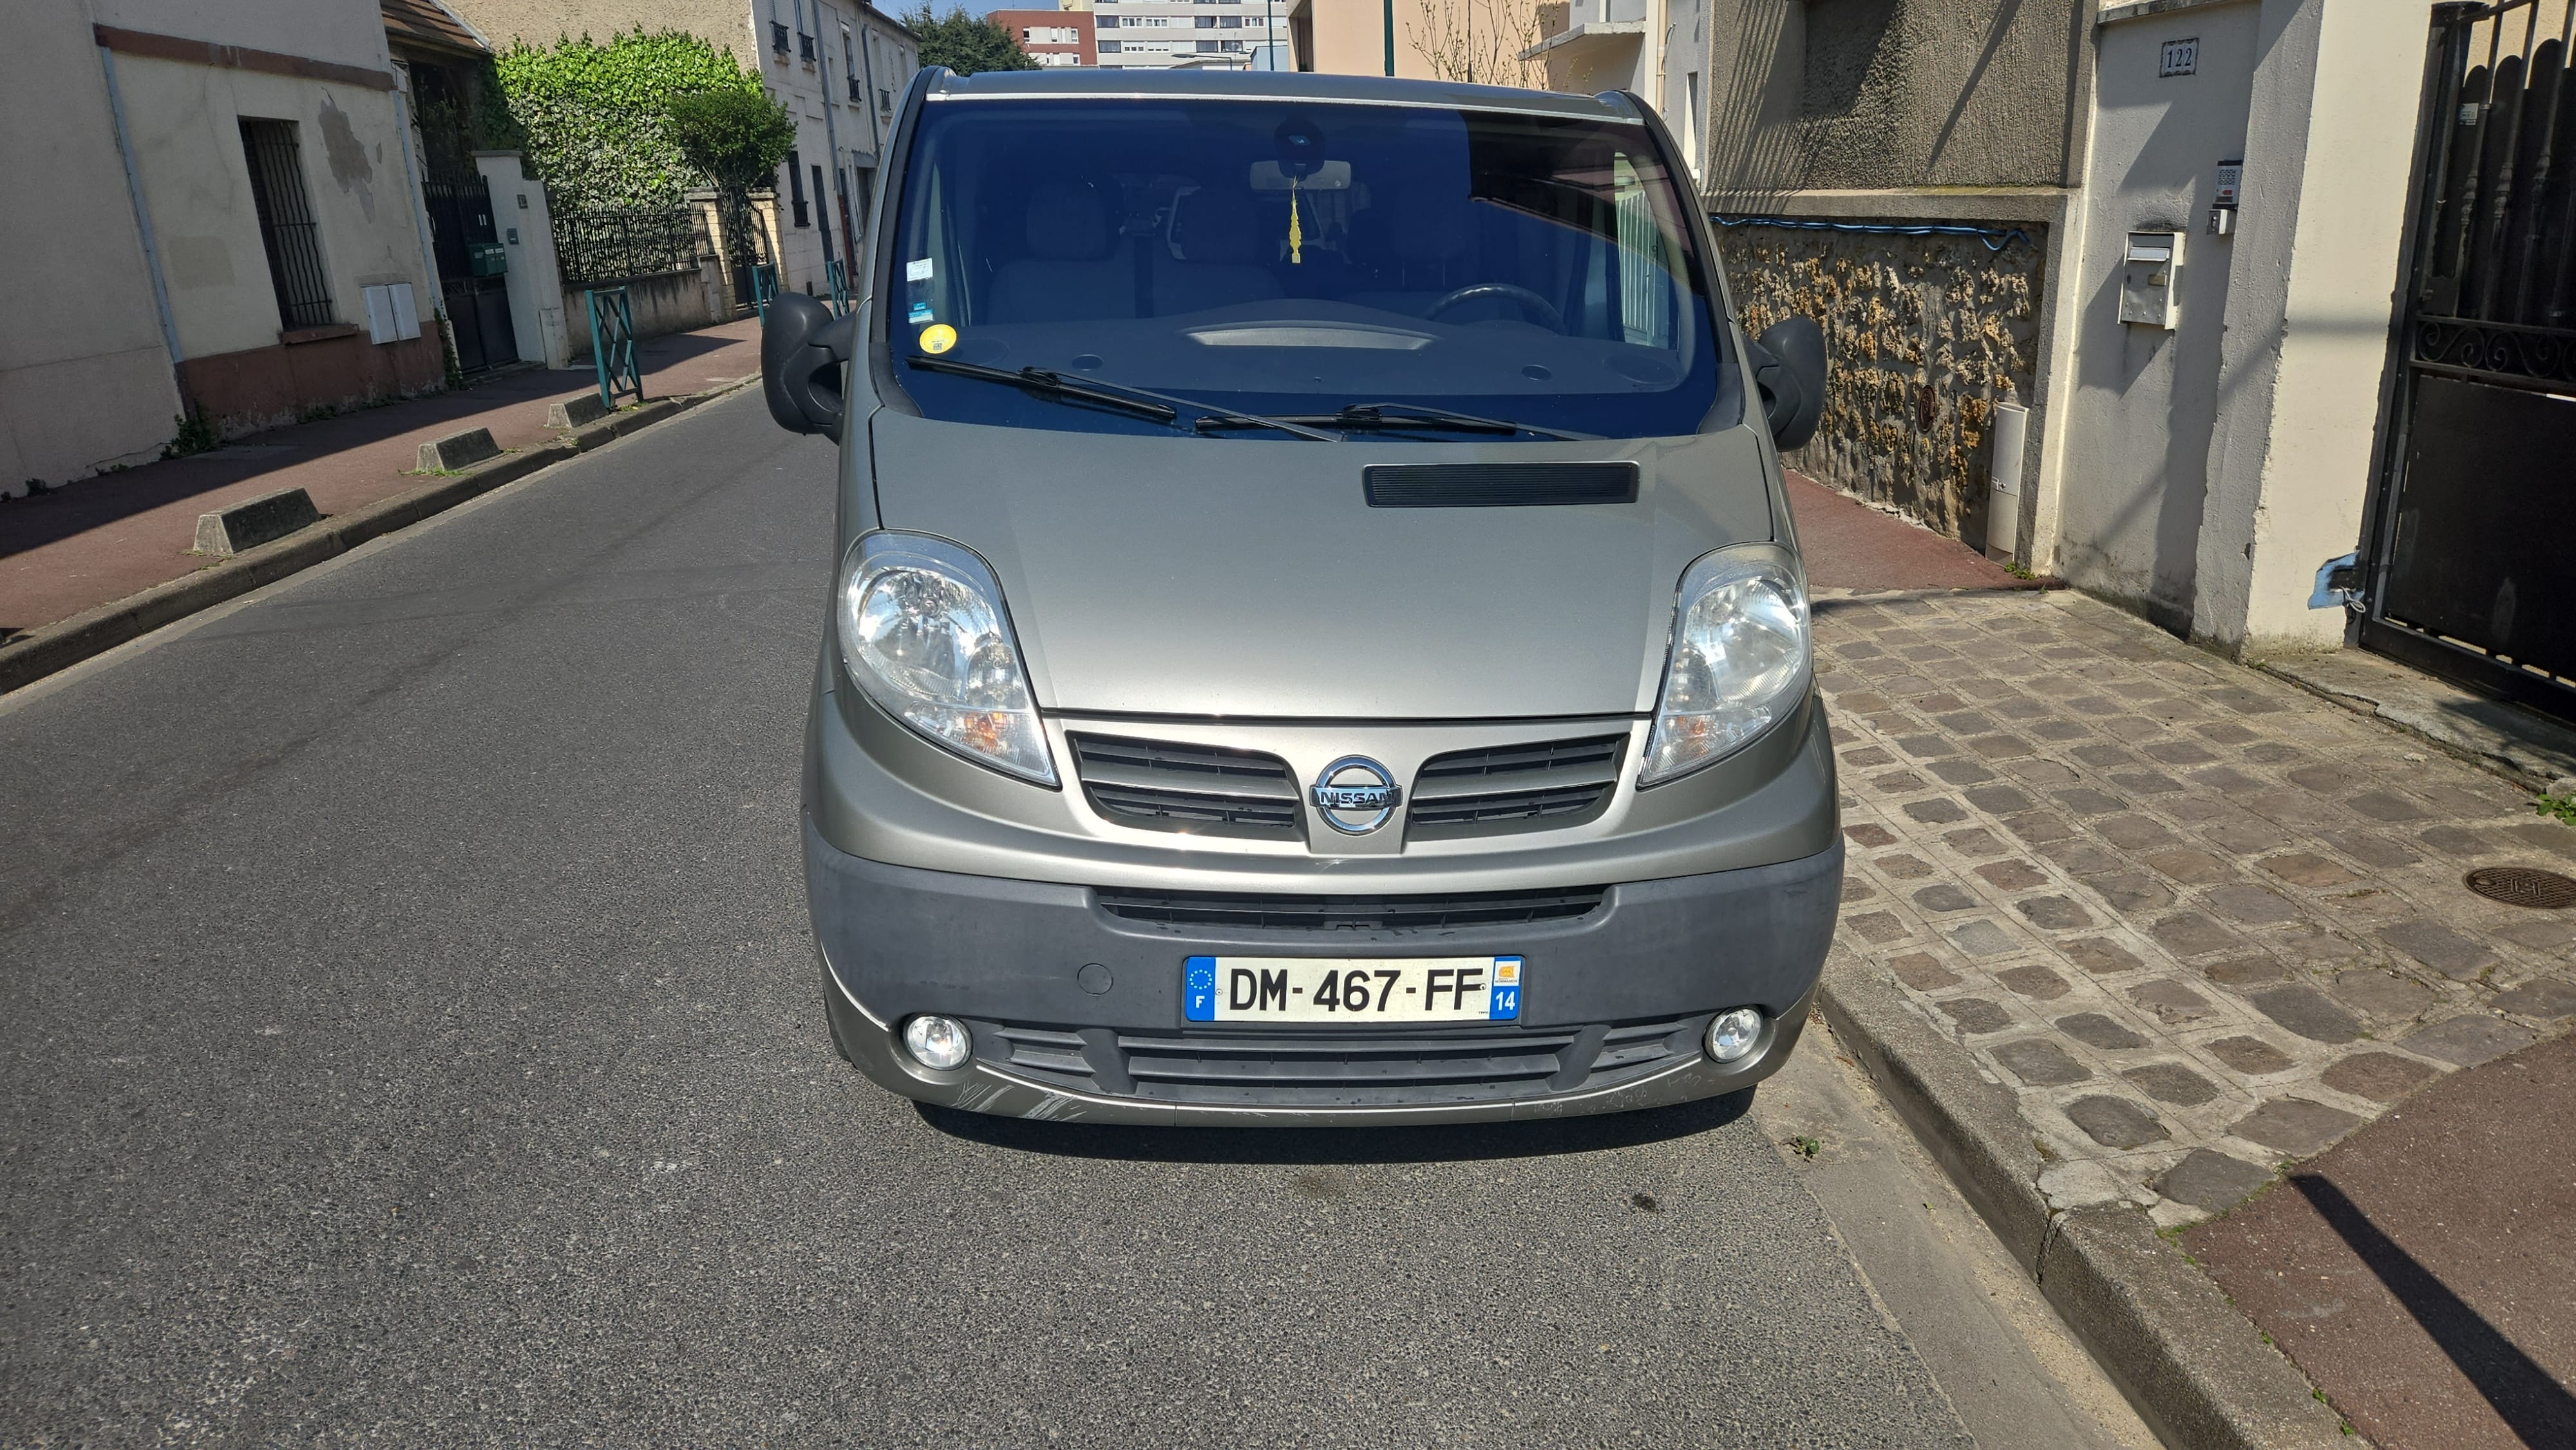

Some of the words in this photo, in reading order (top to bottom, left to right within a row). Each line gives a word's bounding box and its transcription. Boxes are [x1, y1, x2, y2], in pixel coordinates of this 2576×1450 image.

[2167, 48, 2192, 68] 122
[1320, 791, 1394, 804] NISSAN
[1229, 968, 1484, 1012] DM-467-FF
[1195, 995, 1205, 1008] F
[1495, 991, 1515, 1011] 14
